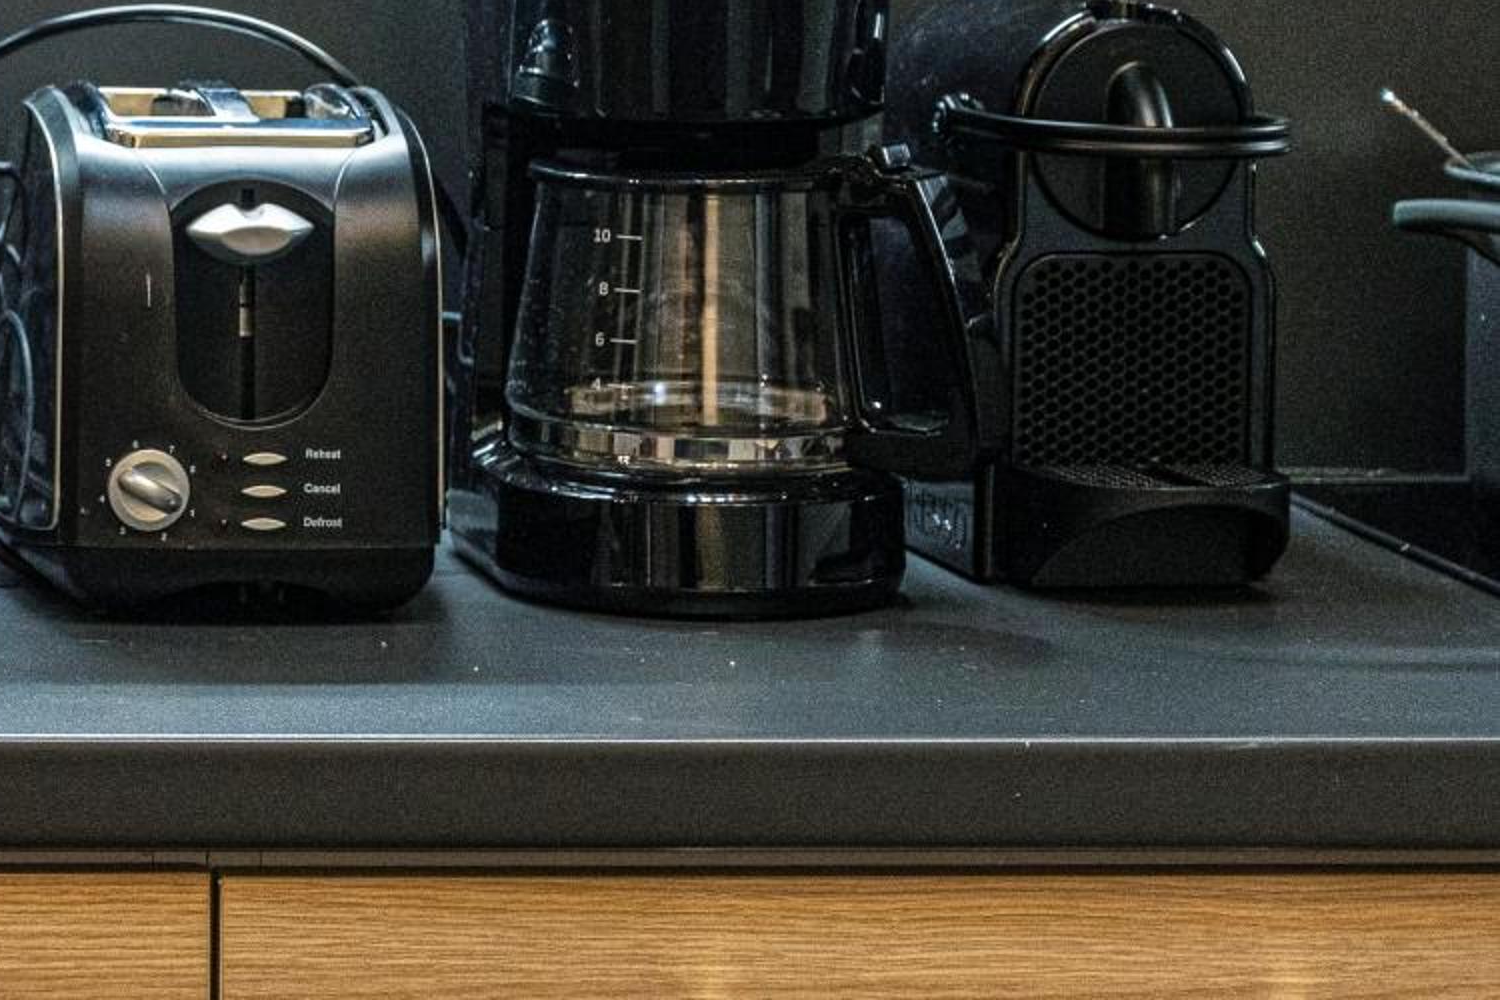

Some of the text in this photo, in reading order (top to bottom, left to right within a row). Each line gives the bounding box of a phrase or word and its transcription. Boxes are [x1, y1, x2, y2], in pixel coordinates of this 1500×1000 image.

[593, 228, 611, 243] 10
[599, 282, 609, 296] 8
[595, 332, 605, 347] 6
[305, 447, 341, 460] Reheat
[303, 483, 341, 494] Cancel
[303, 516, 343, 528] Defrost
